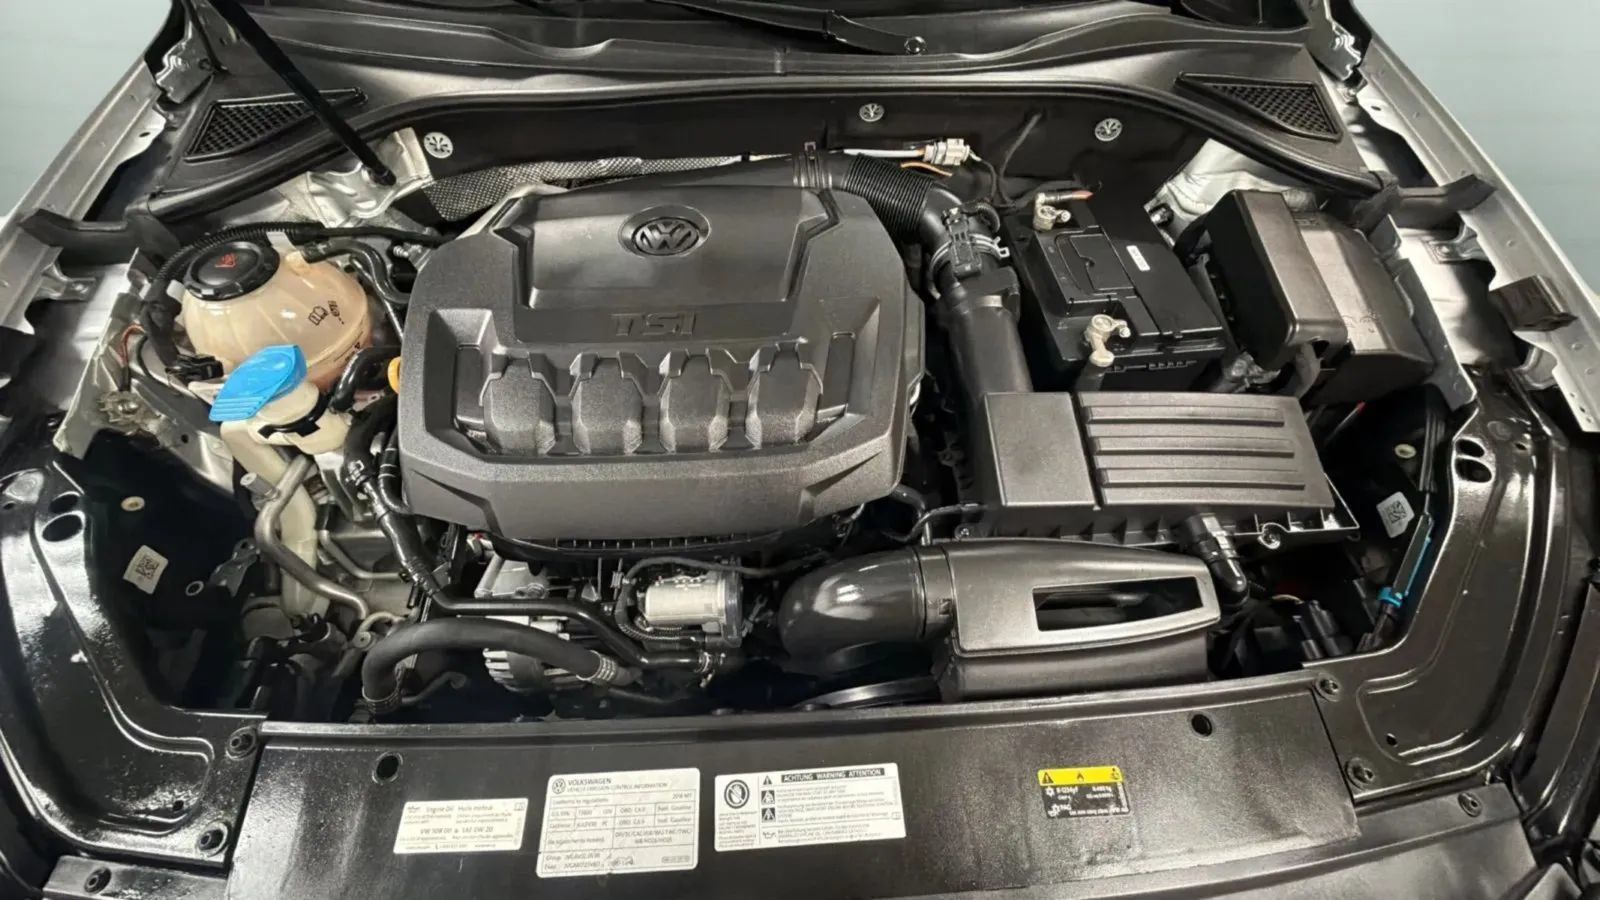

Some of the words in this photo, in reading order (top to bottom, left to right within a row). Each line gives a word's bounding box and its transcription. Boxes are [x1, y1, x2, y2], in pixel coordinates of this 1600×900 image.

[611, 312, 697, 336] TSI
[783, 772, 814, 782] ACHTUNG
[816, 770, 846, 780] WARNING
[848, 768, 881, 778] ATTENTION
[567, 778, 612, 787] VOLKSWAGEN
[634, 782, 668, 790] INFORMATION
